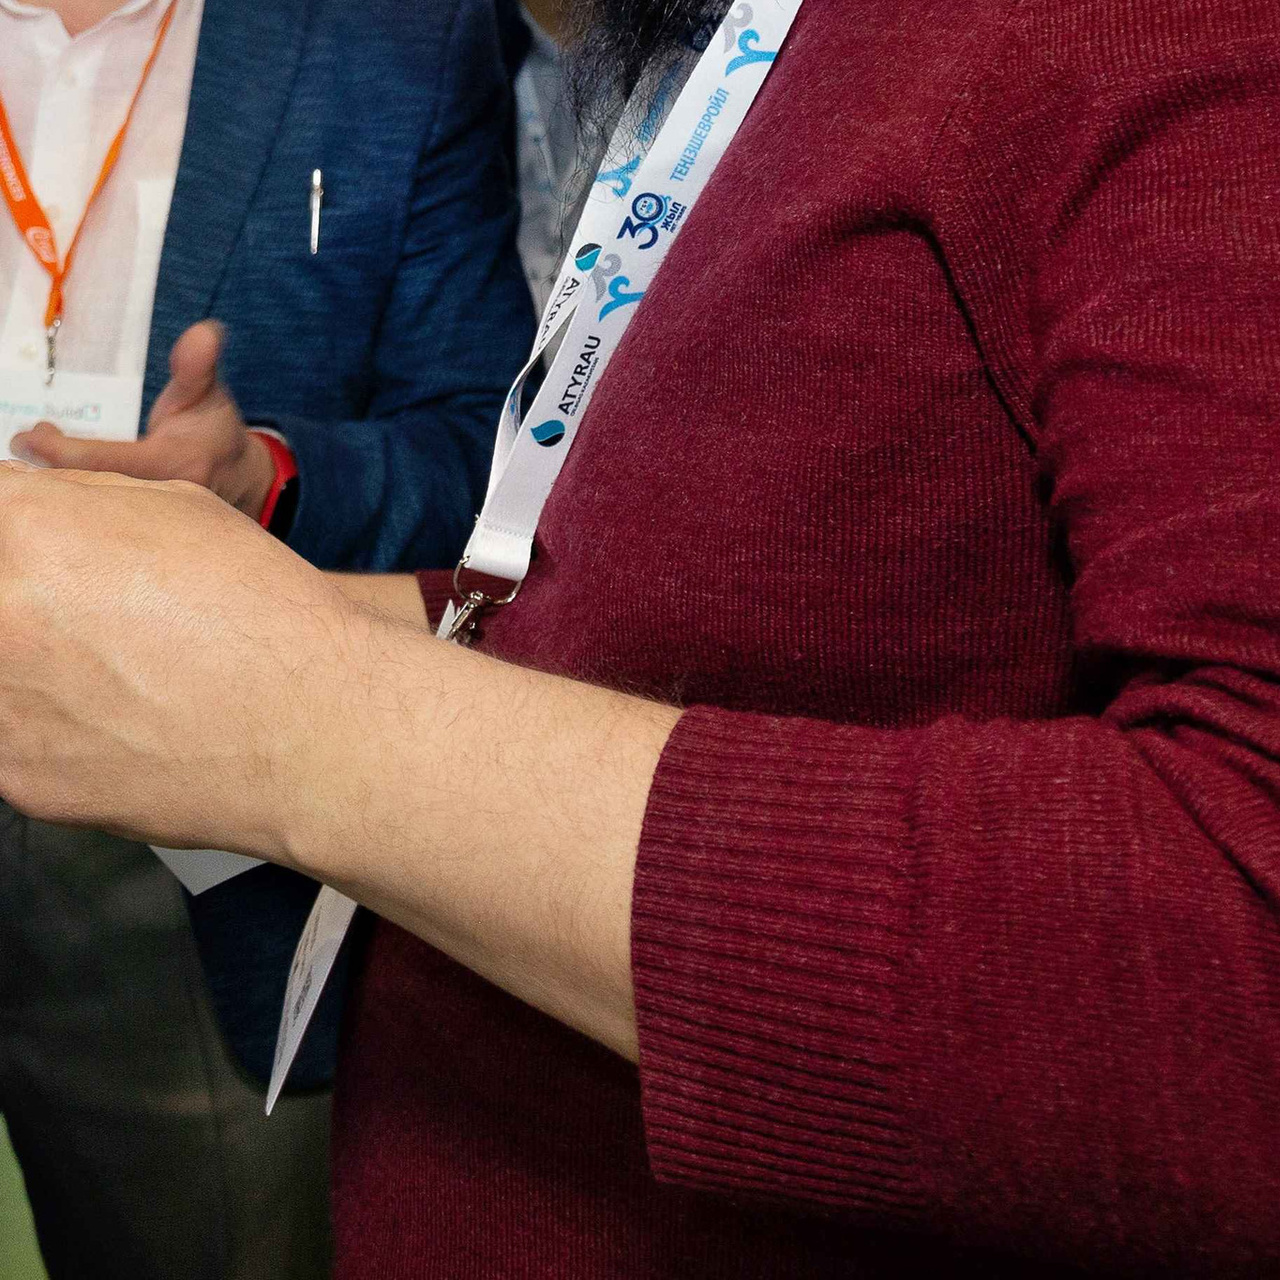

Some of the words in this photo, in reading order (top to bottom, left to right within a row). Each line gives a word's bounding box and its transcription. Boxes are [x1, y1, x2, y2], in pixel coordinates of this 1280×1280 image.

[616, 192, 664, 250] 30
[660, 201, 682, 231] ЖЫЛ
[558, 335, 601, 415] ATYRAU
